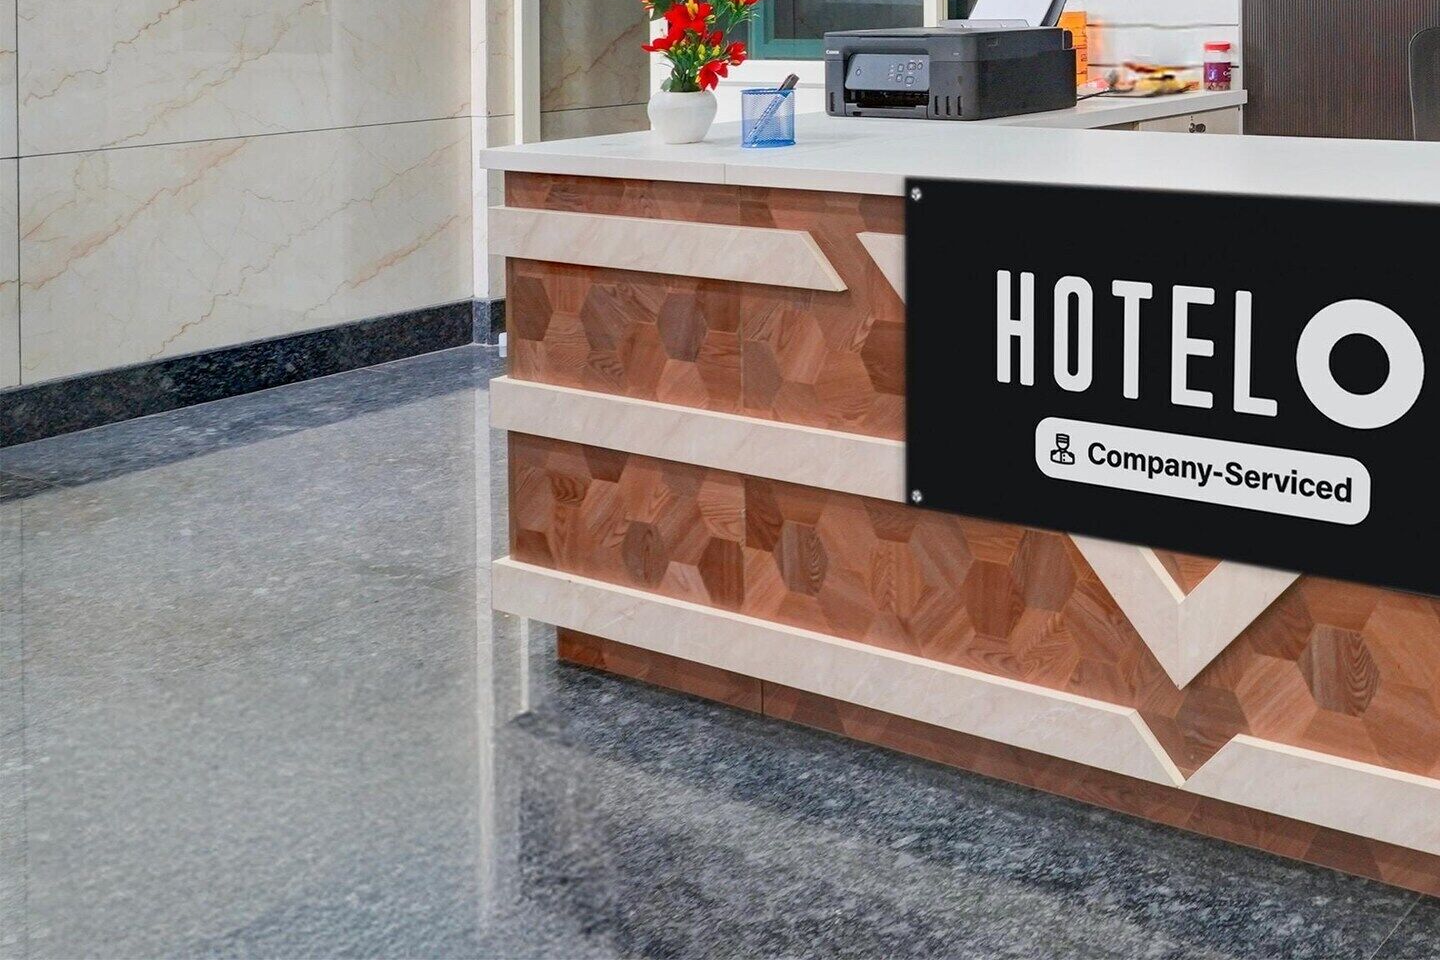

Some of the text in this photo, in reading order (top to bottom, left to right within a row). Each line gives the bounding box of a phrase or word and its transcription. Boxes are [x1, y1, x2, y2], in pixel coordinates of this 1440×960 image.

[996, 269, 1425, 430] HOTEL O
[1087, 441, 1353, 504] Company-Serviced
